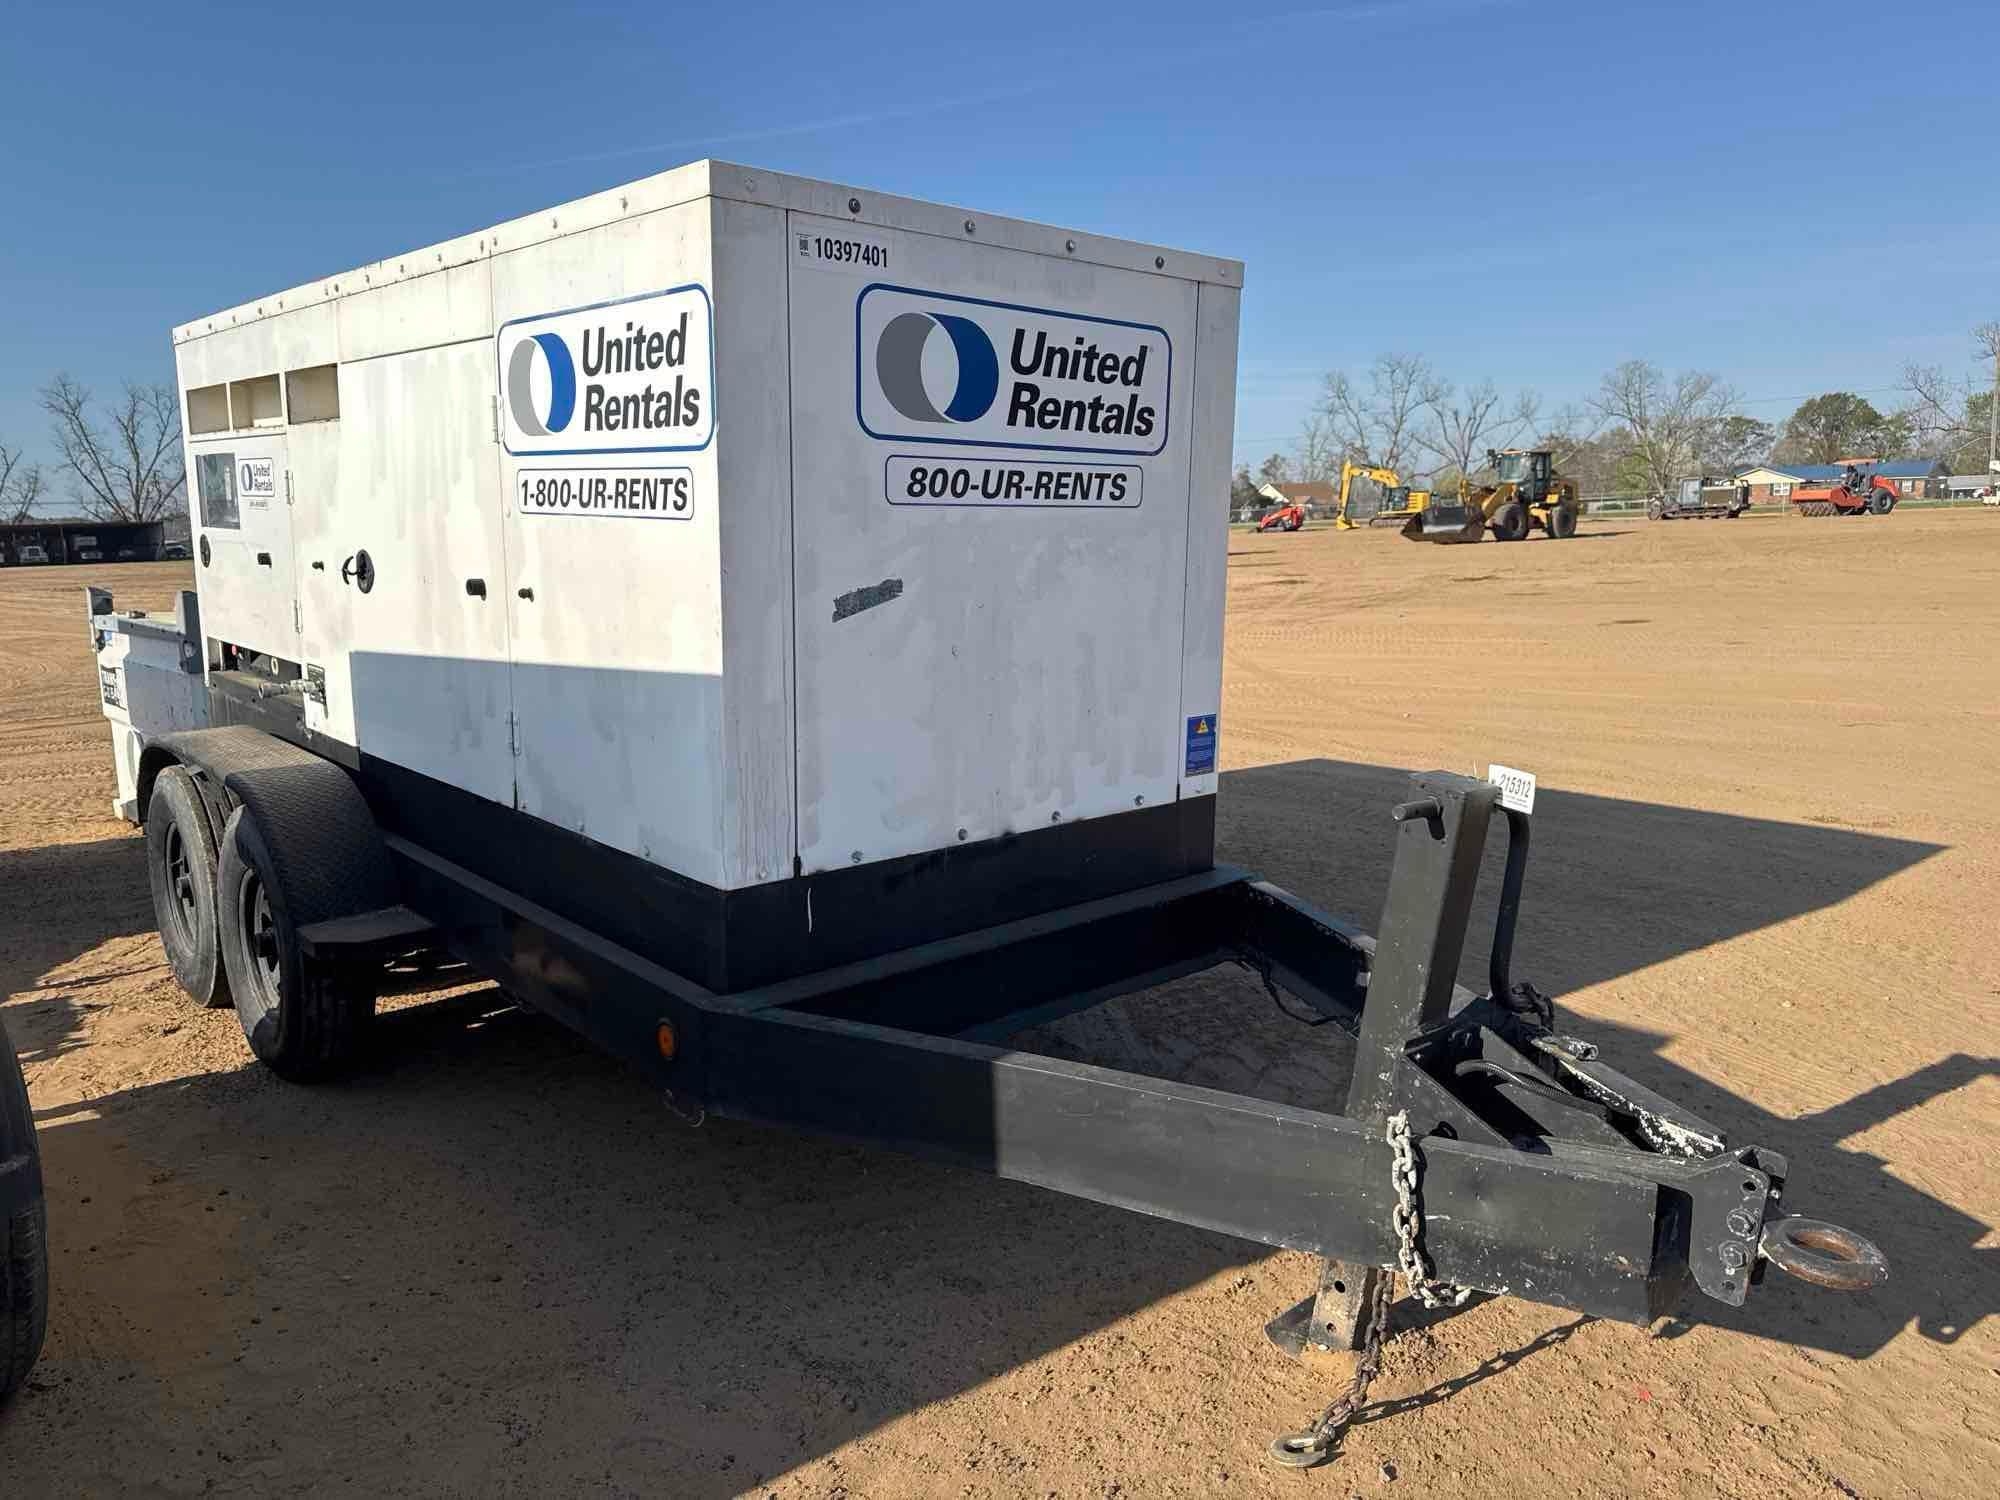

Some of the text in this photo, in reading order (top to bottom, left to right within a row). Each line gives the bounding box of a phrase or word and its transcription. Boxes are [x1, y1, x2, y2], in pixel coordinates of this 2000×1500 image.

[816, 238, 887, 268] 10397401
[582, 312, 688, 377] United
[1010, 328, 1148, 386] United
[584, 375, 700, 432] Rentals
[1007, 381, 1155, 437] Rentals
[521, 477, 688, 511] 1-800-UR-RENTS
[906, 467, 1127, 501] 800-UR-RENTS
